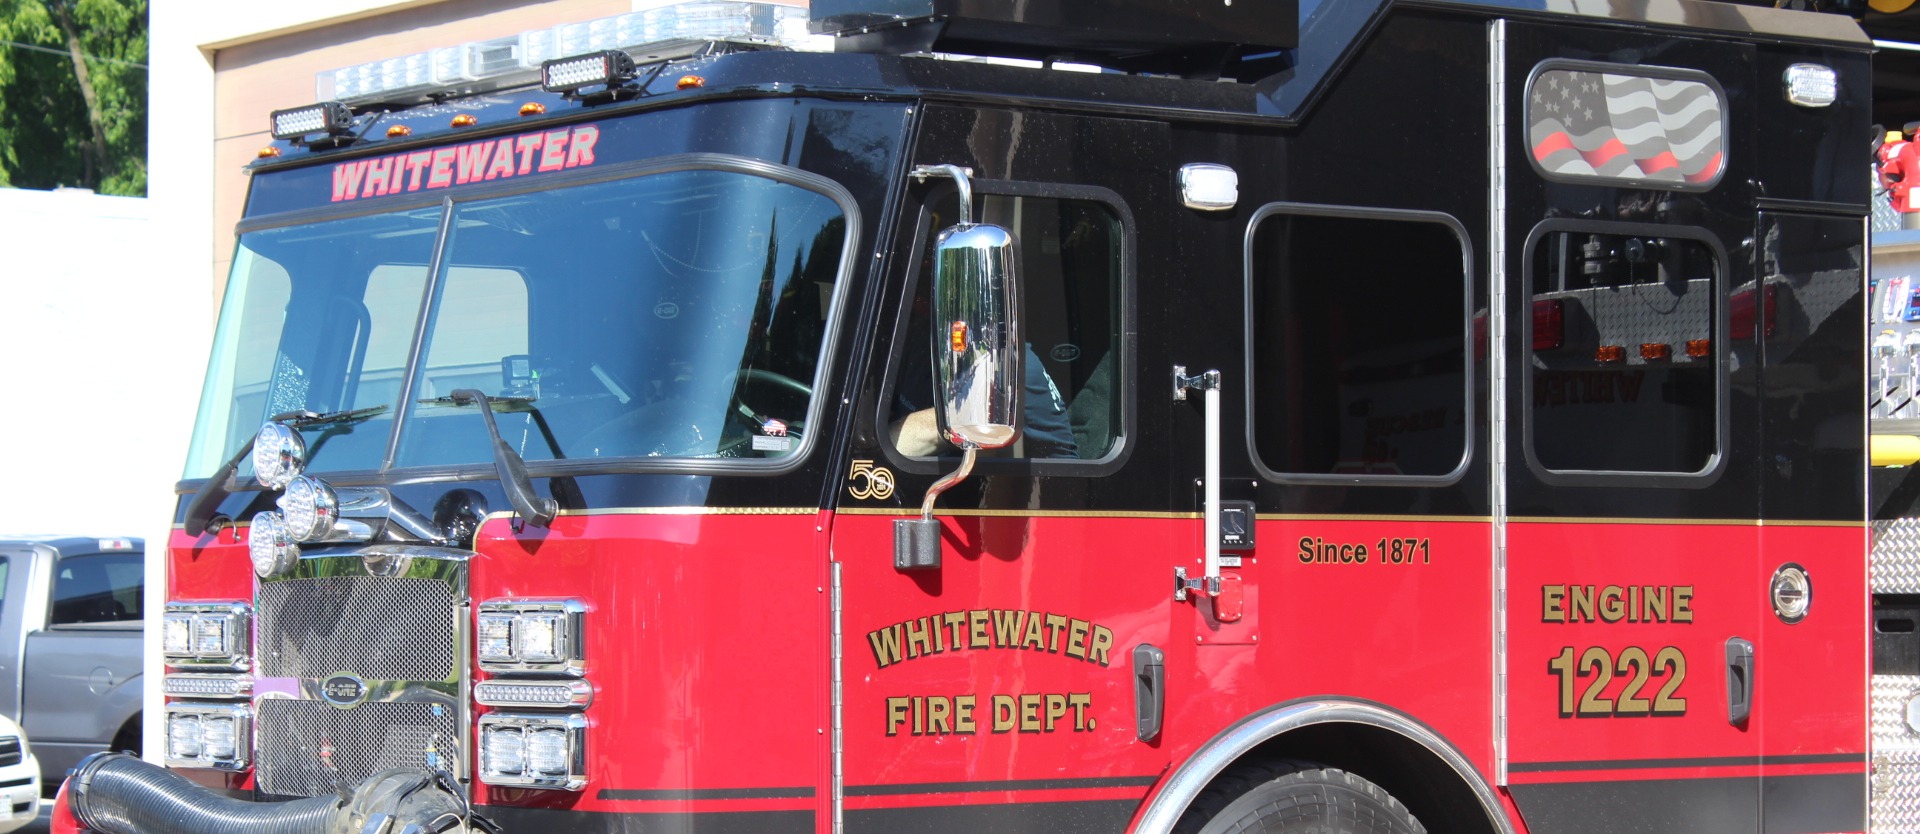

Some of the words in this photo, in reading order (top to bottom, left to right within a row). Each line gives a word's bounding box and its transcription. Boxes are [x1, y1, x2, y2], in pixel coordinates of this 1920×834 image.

[332, 124, 599, 202] WHITEWATER
[1299, 536, 1368, 564] Since
[1376, 537, 1430, 564] 1871
[1541, 584, 1693, 624] ENGINE
[866, 608, 1113, 669] WHITEWATER
[1548, 645, 1687, 719] 1222
[885, 693, 977, 736] FIRE
[991, 692, 1096, 735] DEPT.
